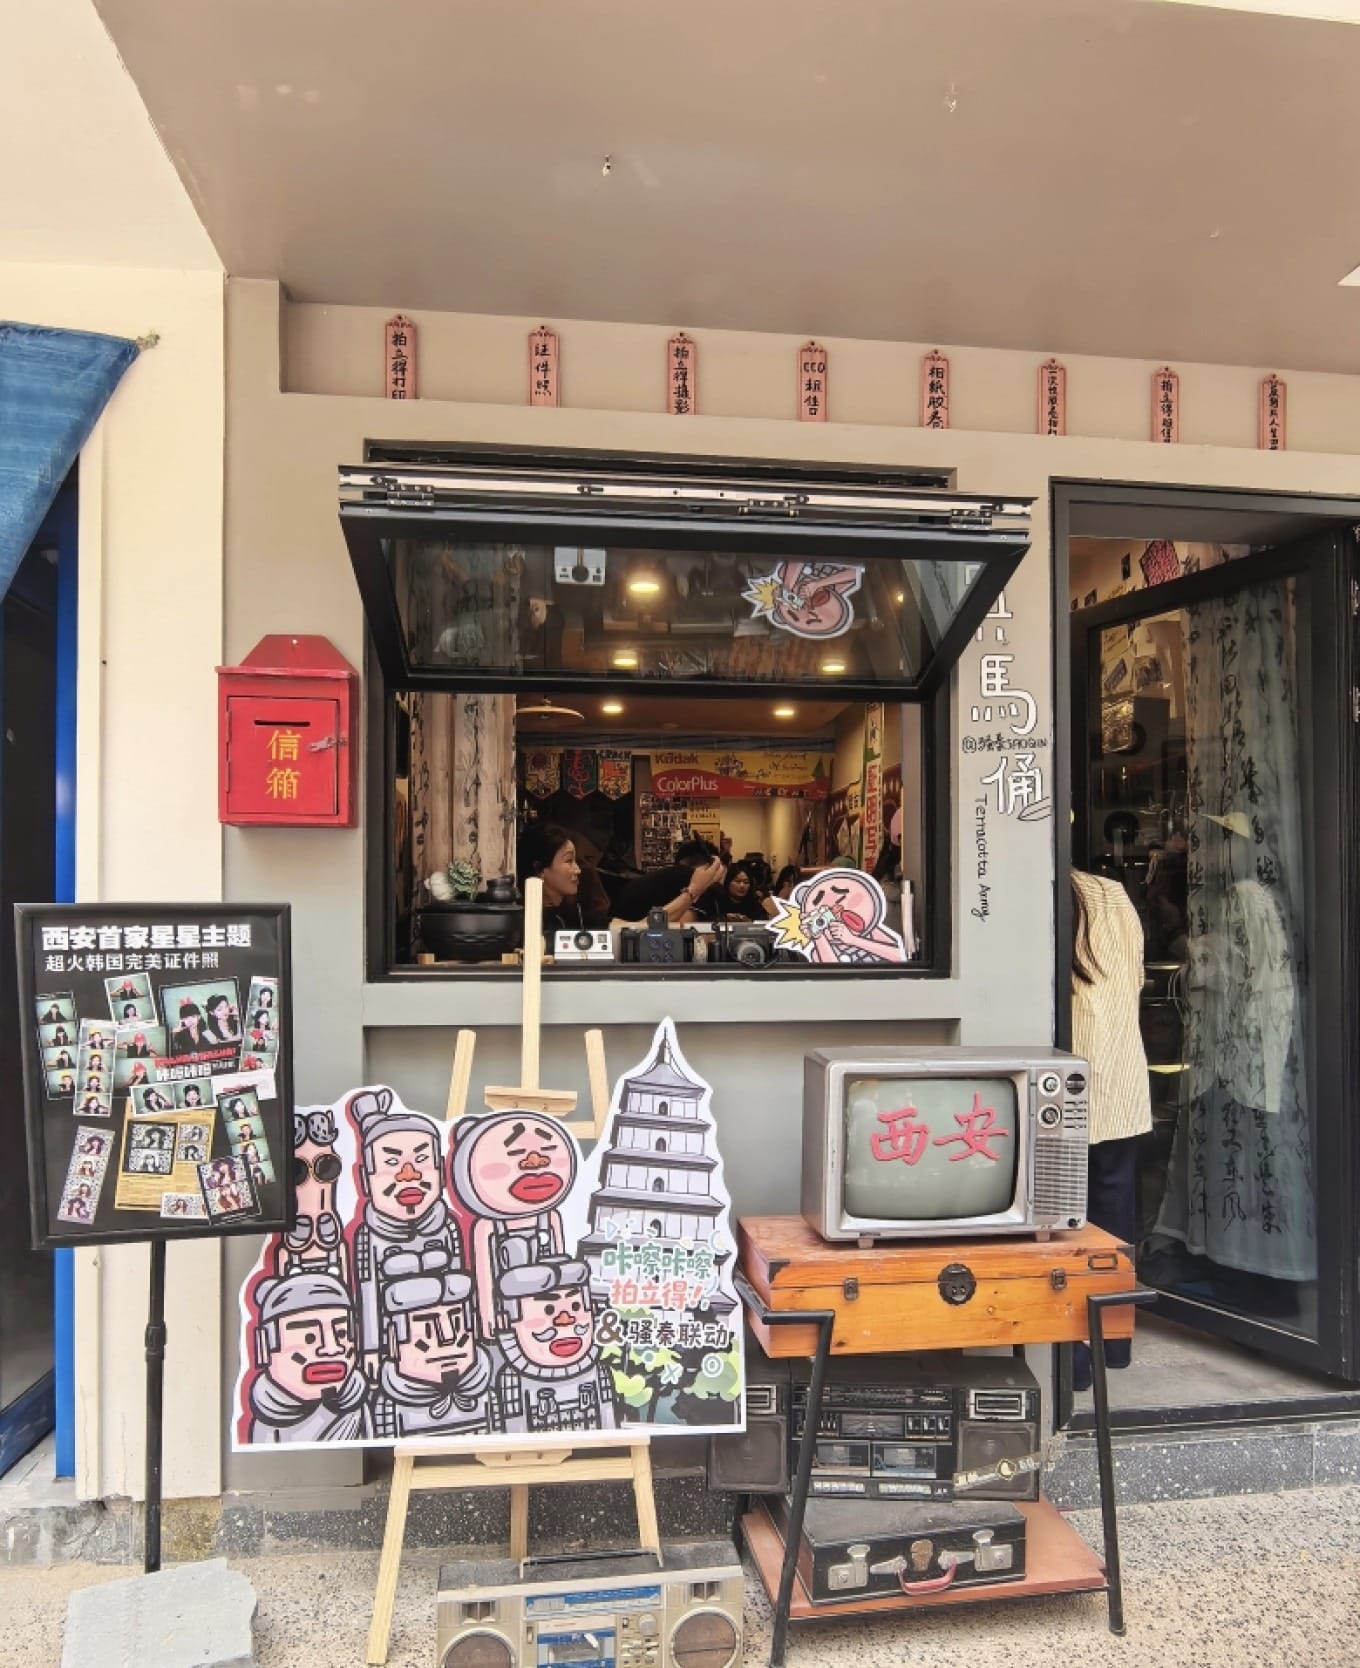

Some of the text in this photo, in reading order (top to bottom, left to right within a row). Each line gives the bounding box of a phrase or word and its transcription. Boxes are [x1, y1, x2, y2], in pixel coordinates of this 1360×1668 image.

[265, 729, 303, 800] 信箱
[656, 775, 719, 794] ColorPlus
[40, 924, 252, 951] 西安首家星星主题
[44, 951, 220, 973] 超火韩国完美证件照
[870, 1090, 1009, 1167] 西安
[602, 1241, 714, 1280] 咔嚓咔嚓
